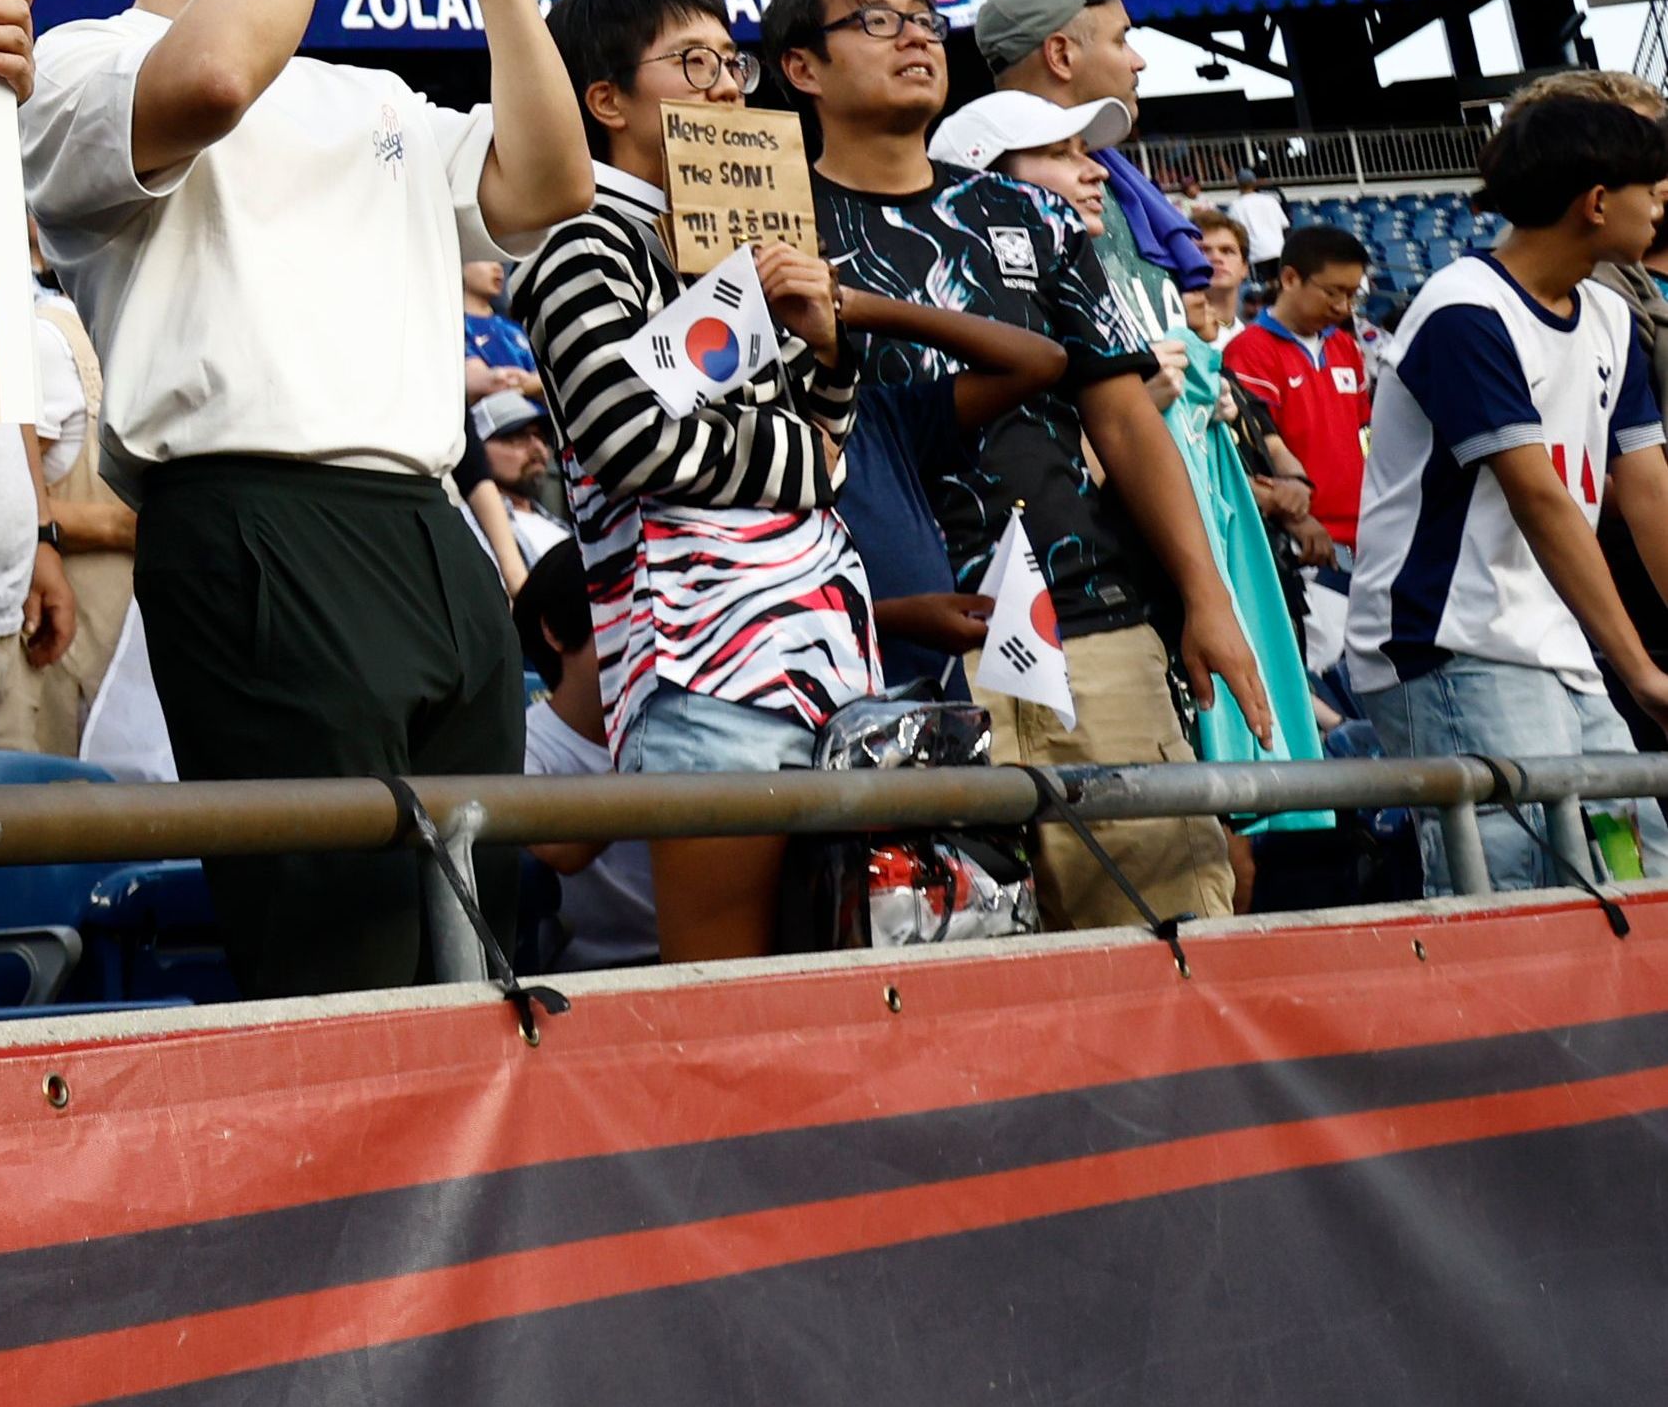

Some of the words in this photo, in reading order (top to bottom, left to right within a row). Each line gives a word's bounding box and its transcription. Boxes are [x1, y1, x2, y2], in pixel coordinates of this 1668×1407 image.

[667, 113, 717, 145] Here
[722, 128, 780, 151] comes
[678, 163, 713, 187] The
